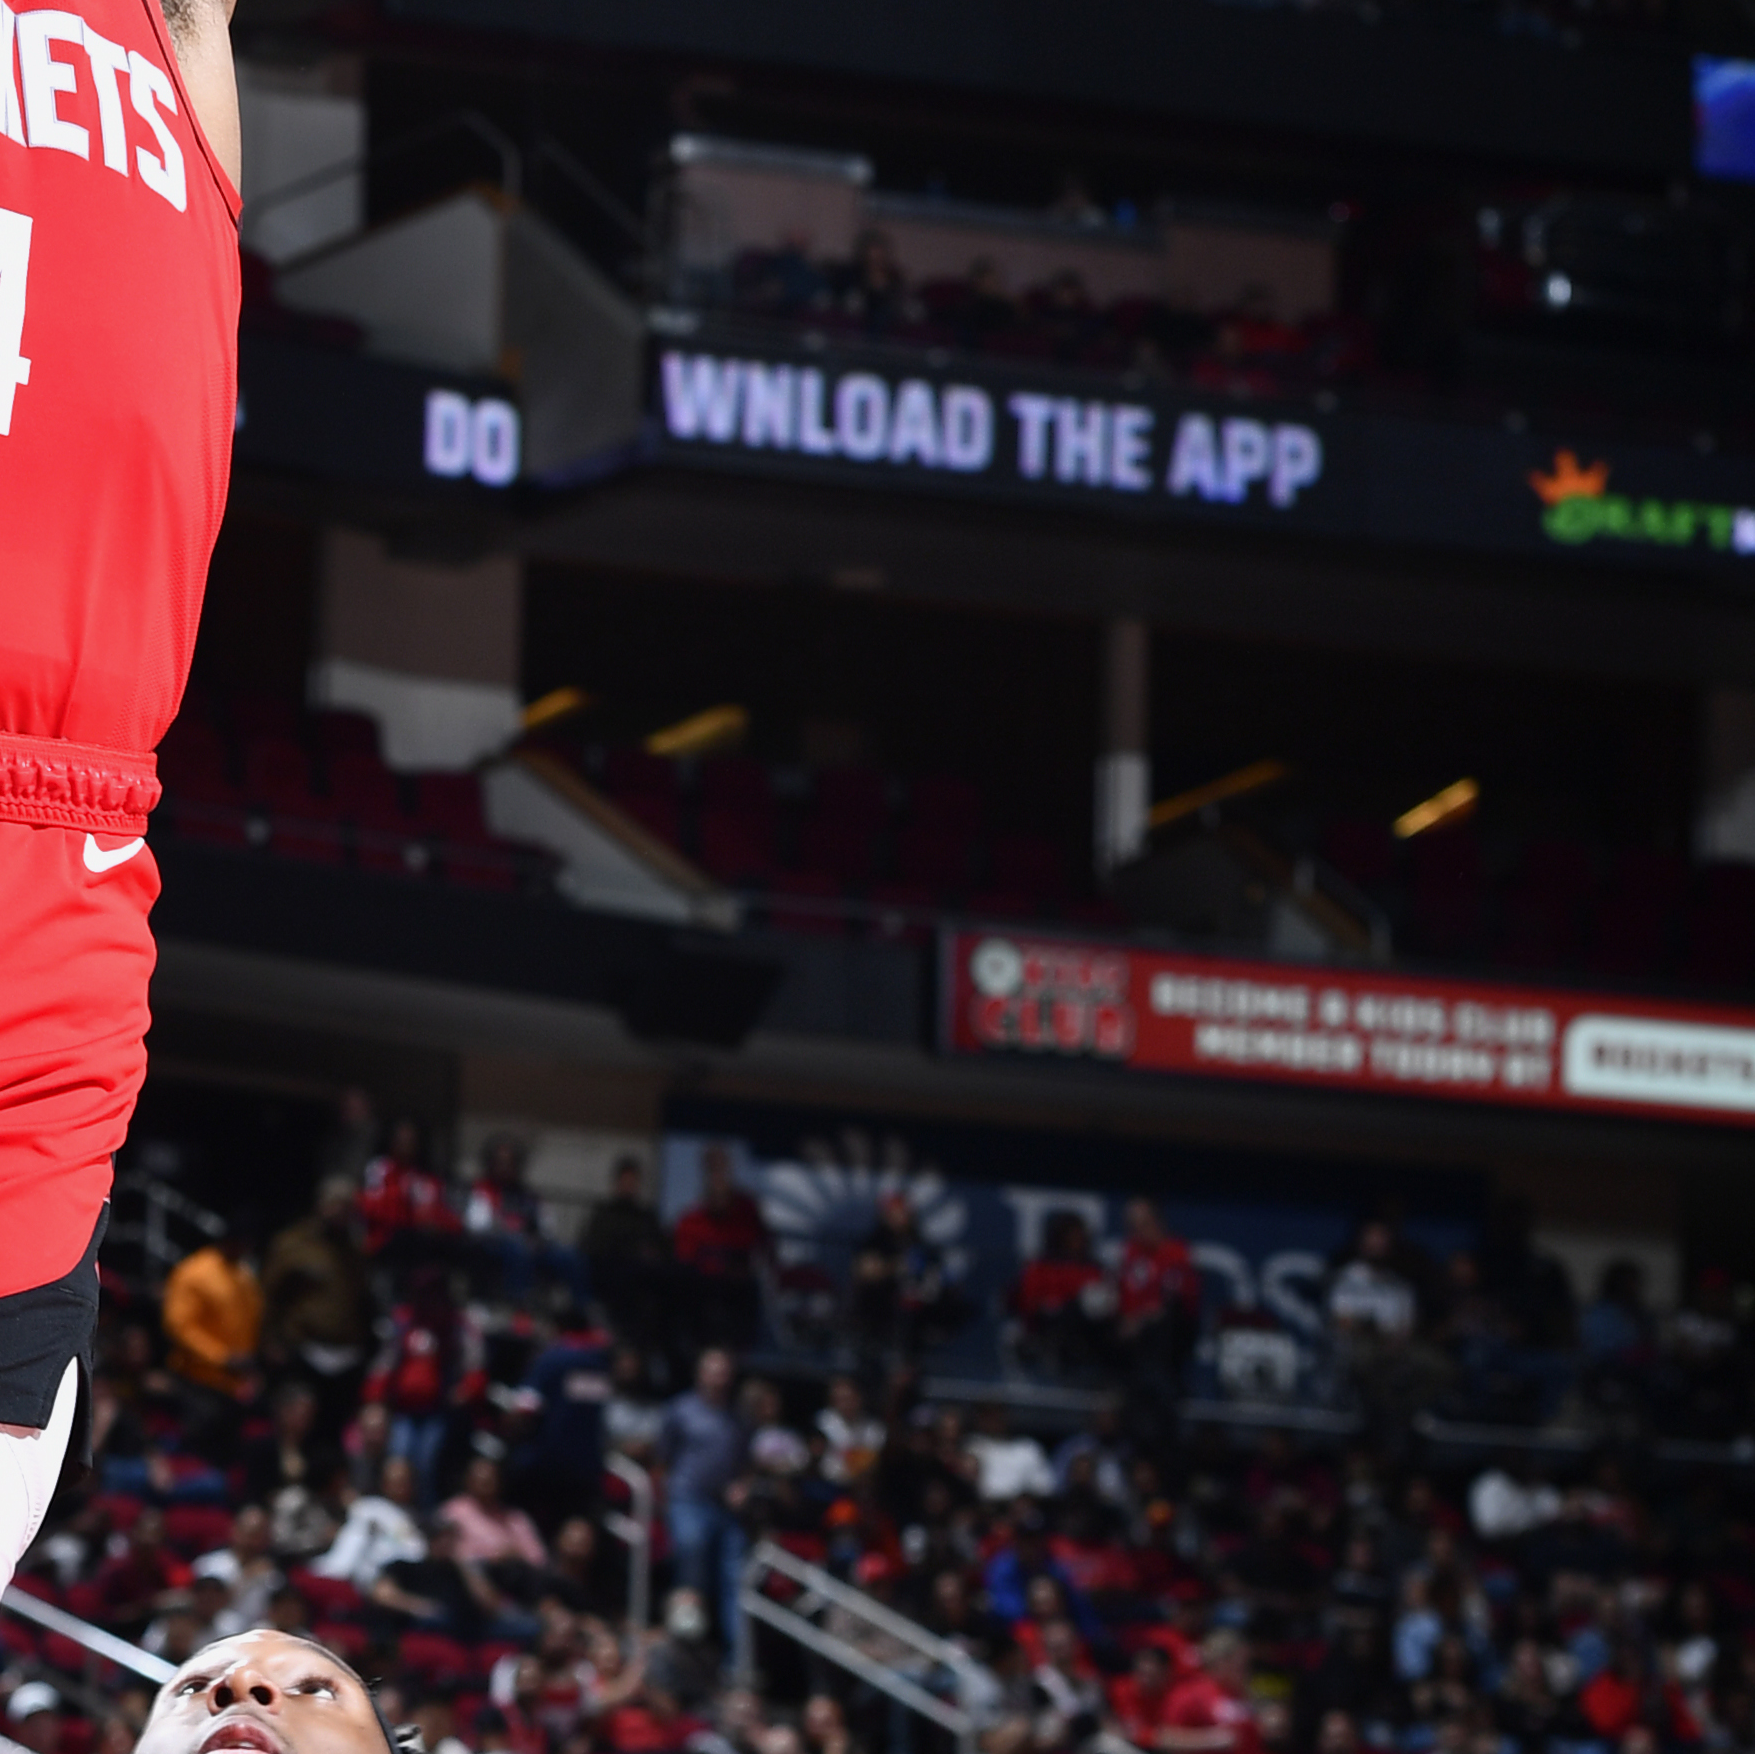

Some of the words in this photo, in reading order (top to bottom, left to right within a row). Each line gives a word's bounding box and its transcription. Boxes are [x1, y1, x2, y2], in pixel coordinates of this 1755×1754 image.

[424, 390, 521, 487] DO
[661, 350, 993, 473] WNLOAD
[1010, 391, 1153, 493] THE
[1169, 413, 1322, 509] APP
